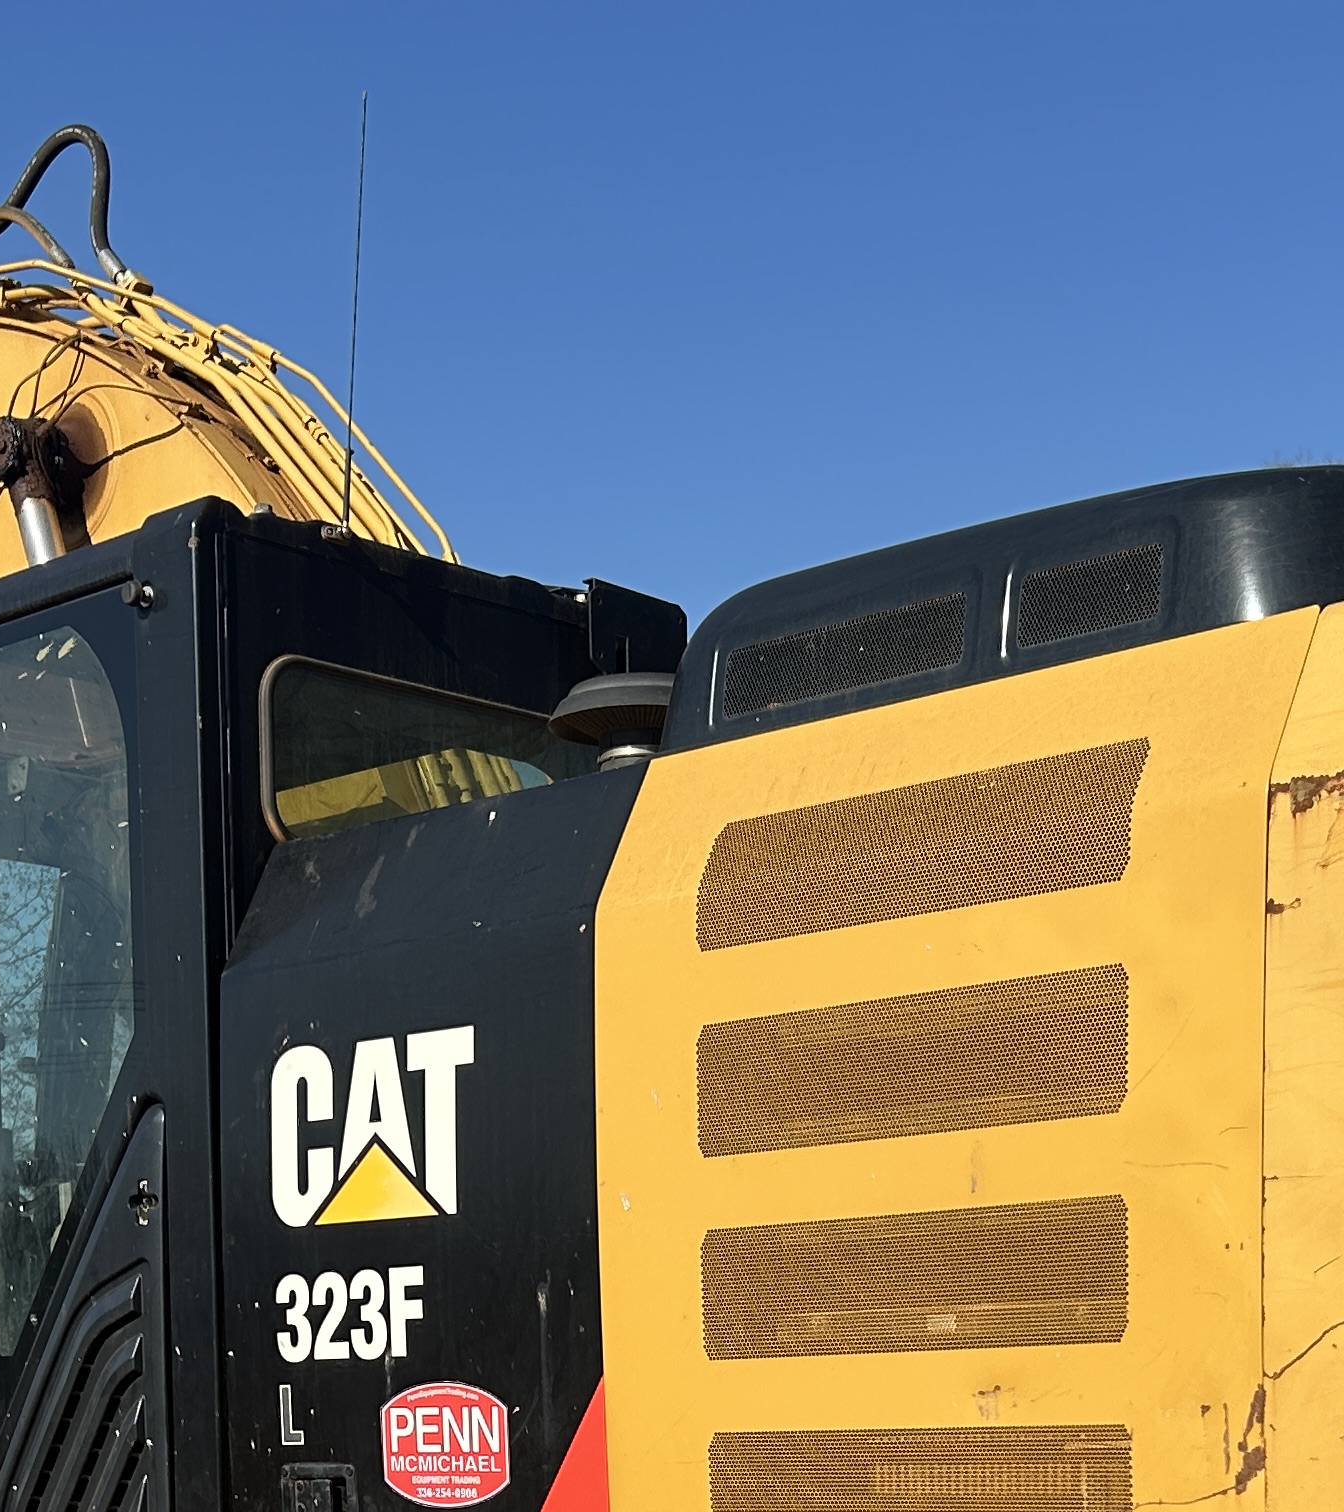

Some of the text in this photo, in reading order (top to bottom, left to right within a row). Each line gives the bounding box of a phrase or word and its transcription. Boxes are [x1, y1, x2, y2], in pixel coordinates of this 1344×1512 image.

[271, 1025, 474, 1228] CAT
[276, 1265, 424, 1364] 323F
[279, 1384, 304, 1446] L
[389, 1406, 500, 1453] PENN
[390, 1455, 502, 1473] MCMICHAEL
[411, 1475, 481, 1485] EQUIPMENT TRADING
